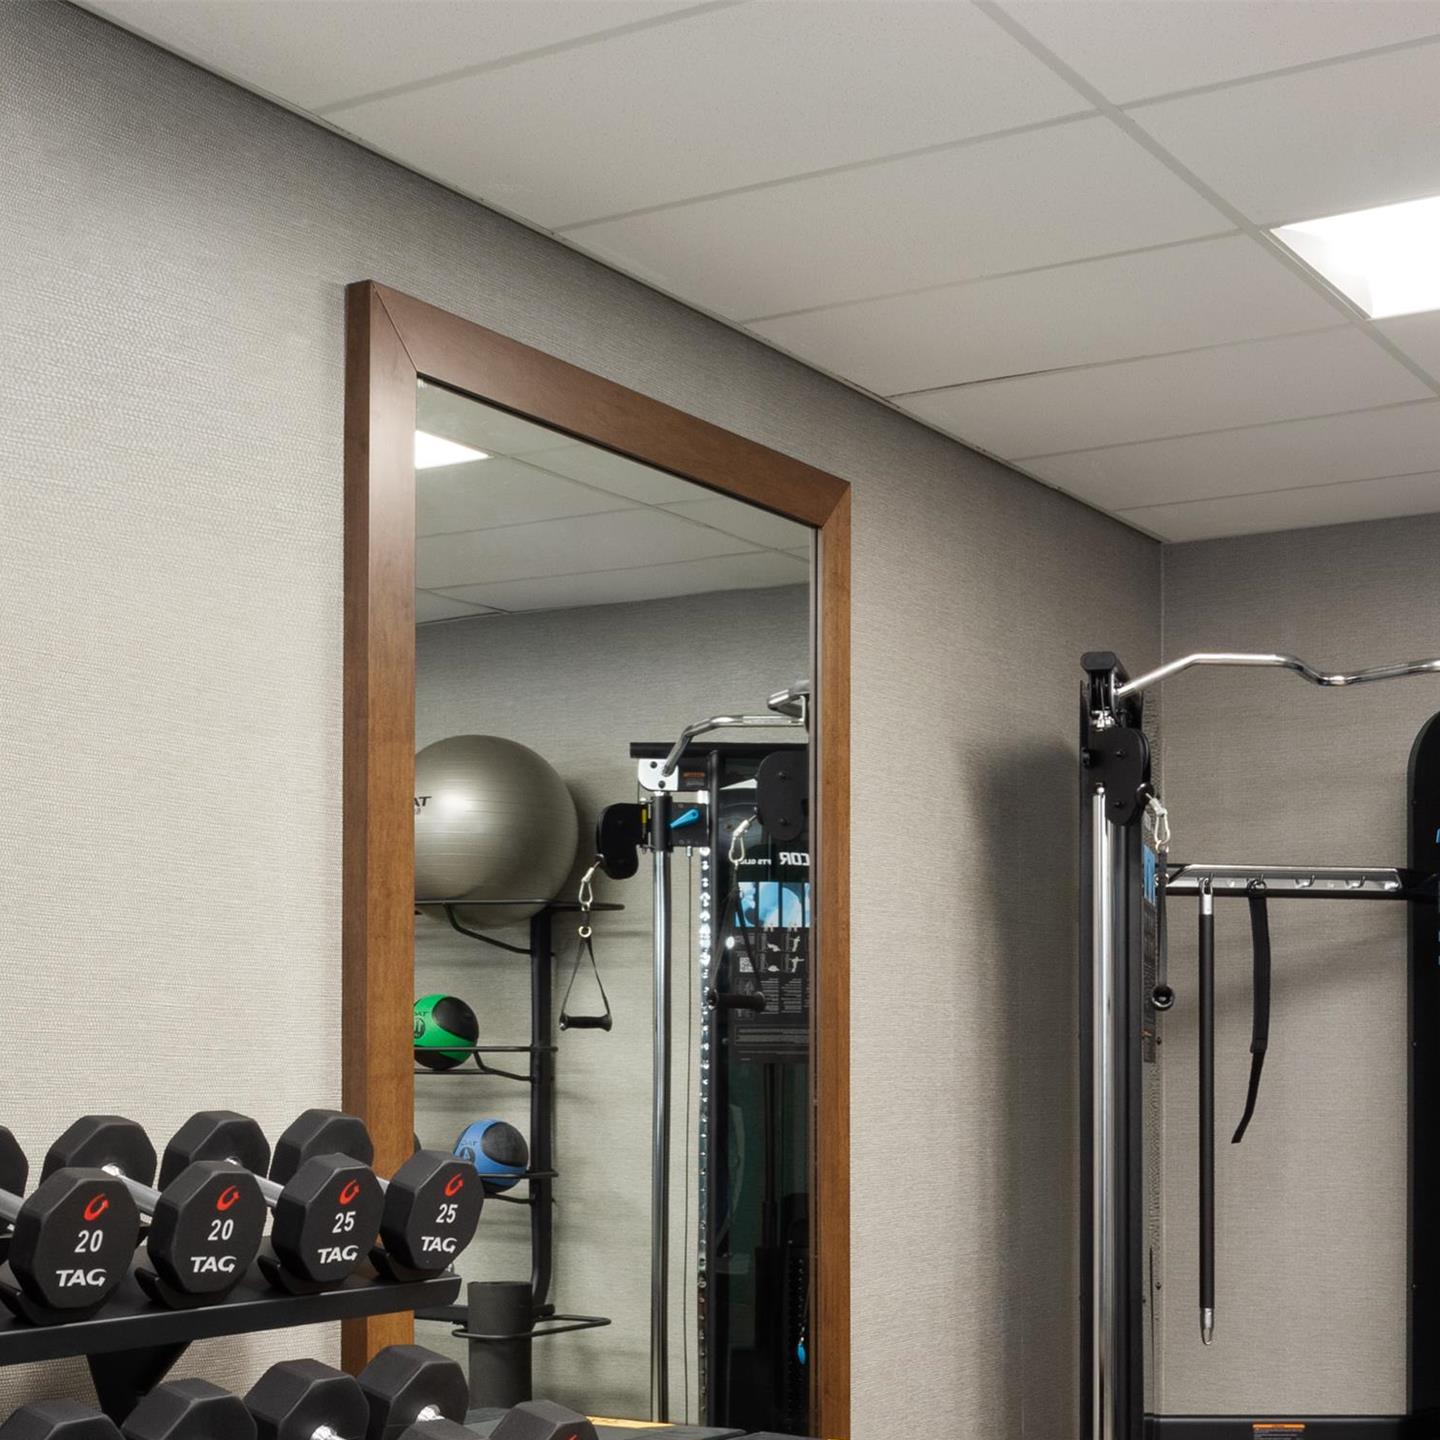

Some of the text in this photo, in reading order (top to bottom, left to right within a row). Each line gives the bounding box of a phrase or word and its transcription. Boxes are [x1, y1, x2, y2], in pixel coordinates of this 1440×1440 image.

[331, 1210, 356, 1234] 25
[435, 1203, 459, 1224] 25
[207, 1217, 234, 1243] 20
[74, 1229, 104, 1253] 20
[420, 1234, 458, 1256] TAG
[190, 1255, 237, 1273] TAG
[317, 1244, 359, 1264] TAG
[55, 1268, 106, 1287] TAG
